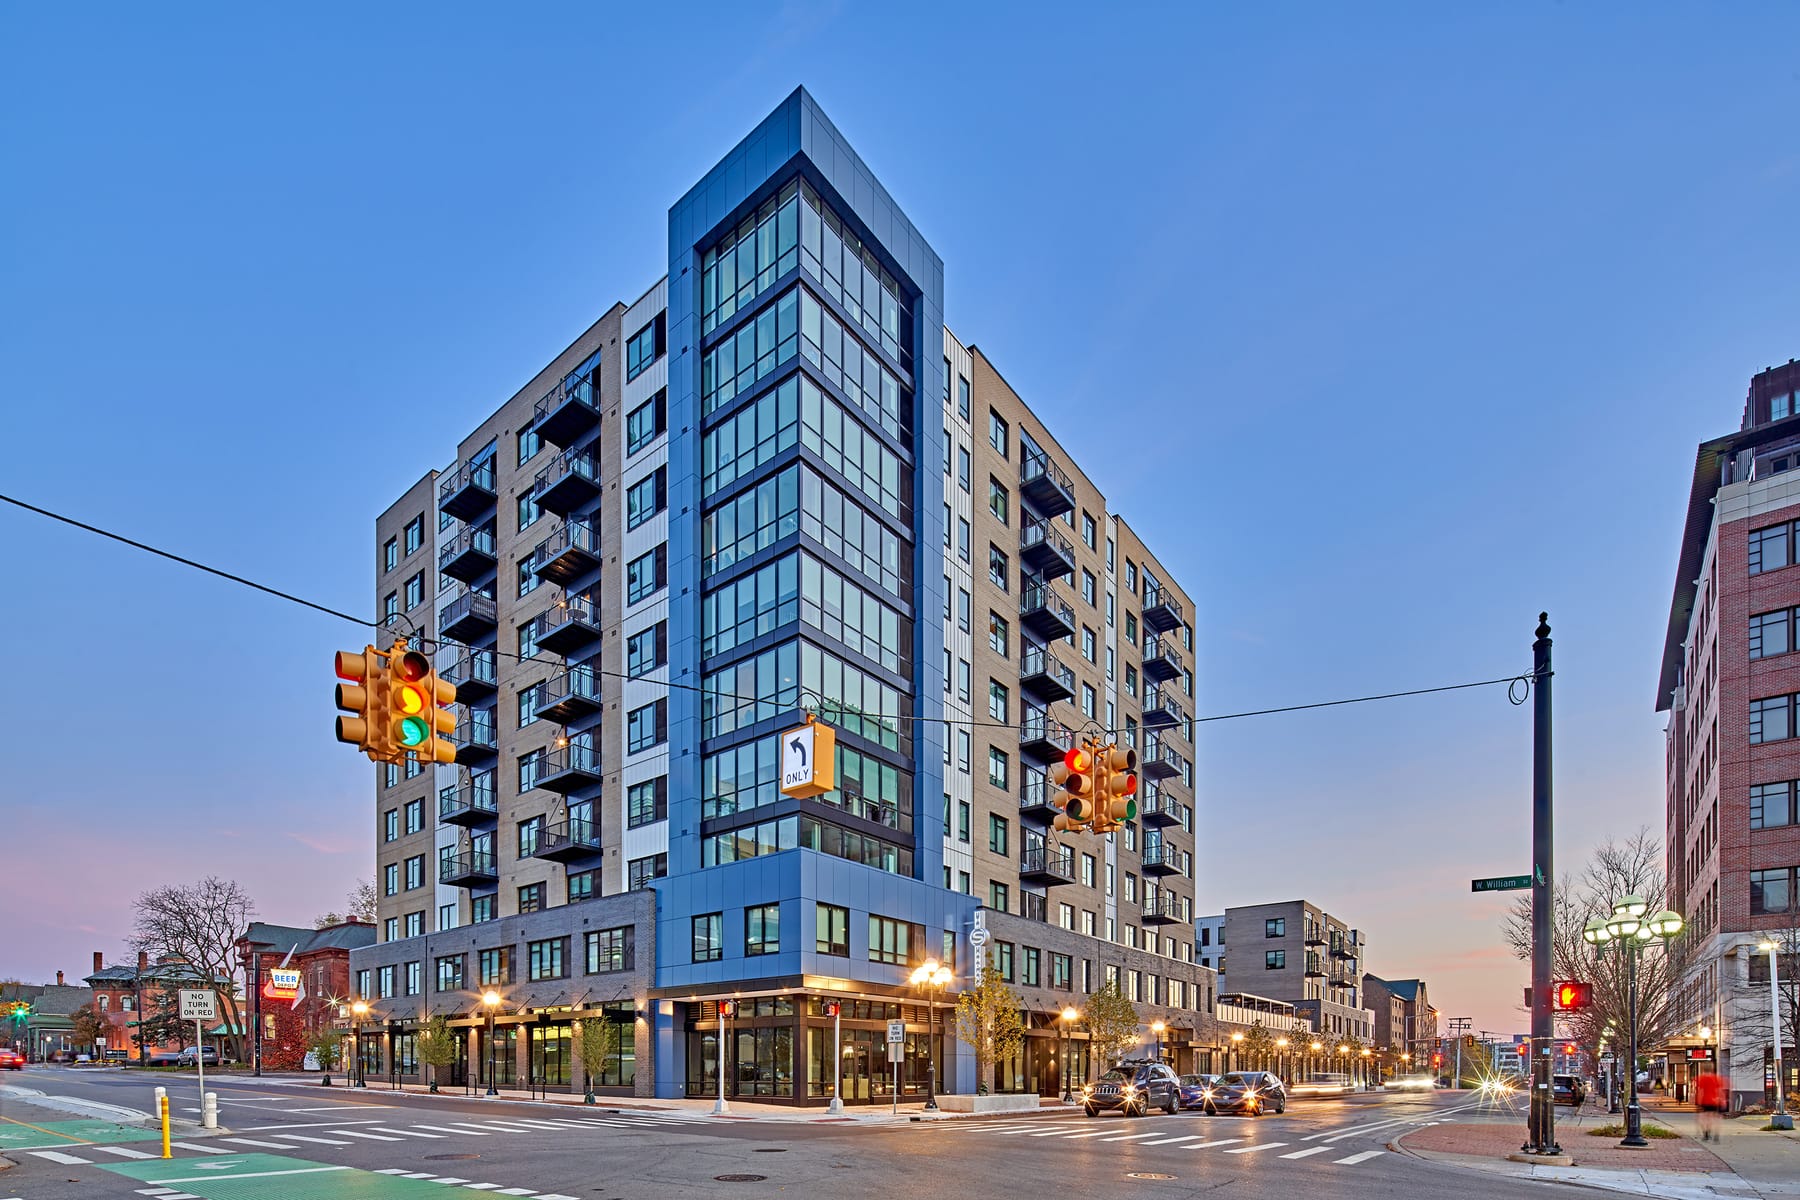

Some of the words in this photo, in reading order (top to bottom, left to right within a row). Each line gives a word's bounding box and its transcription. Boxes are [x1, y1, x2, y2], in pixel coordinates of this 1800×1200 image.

[786, 769, 809, 784] ONLY
[1486, 880, 1516, 888] William
[274, 974, 296, 982] BEER
